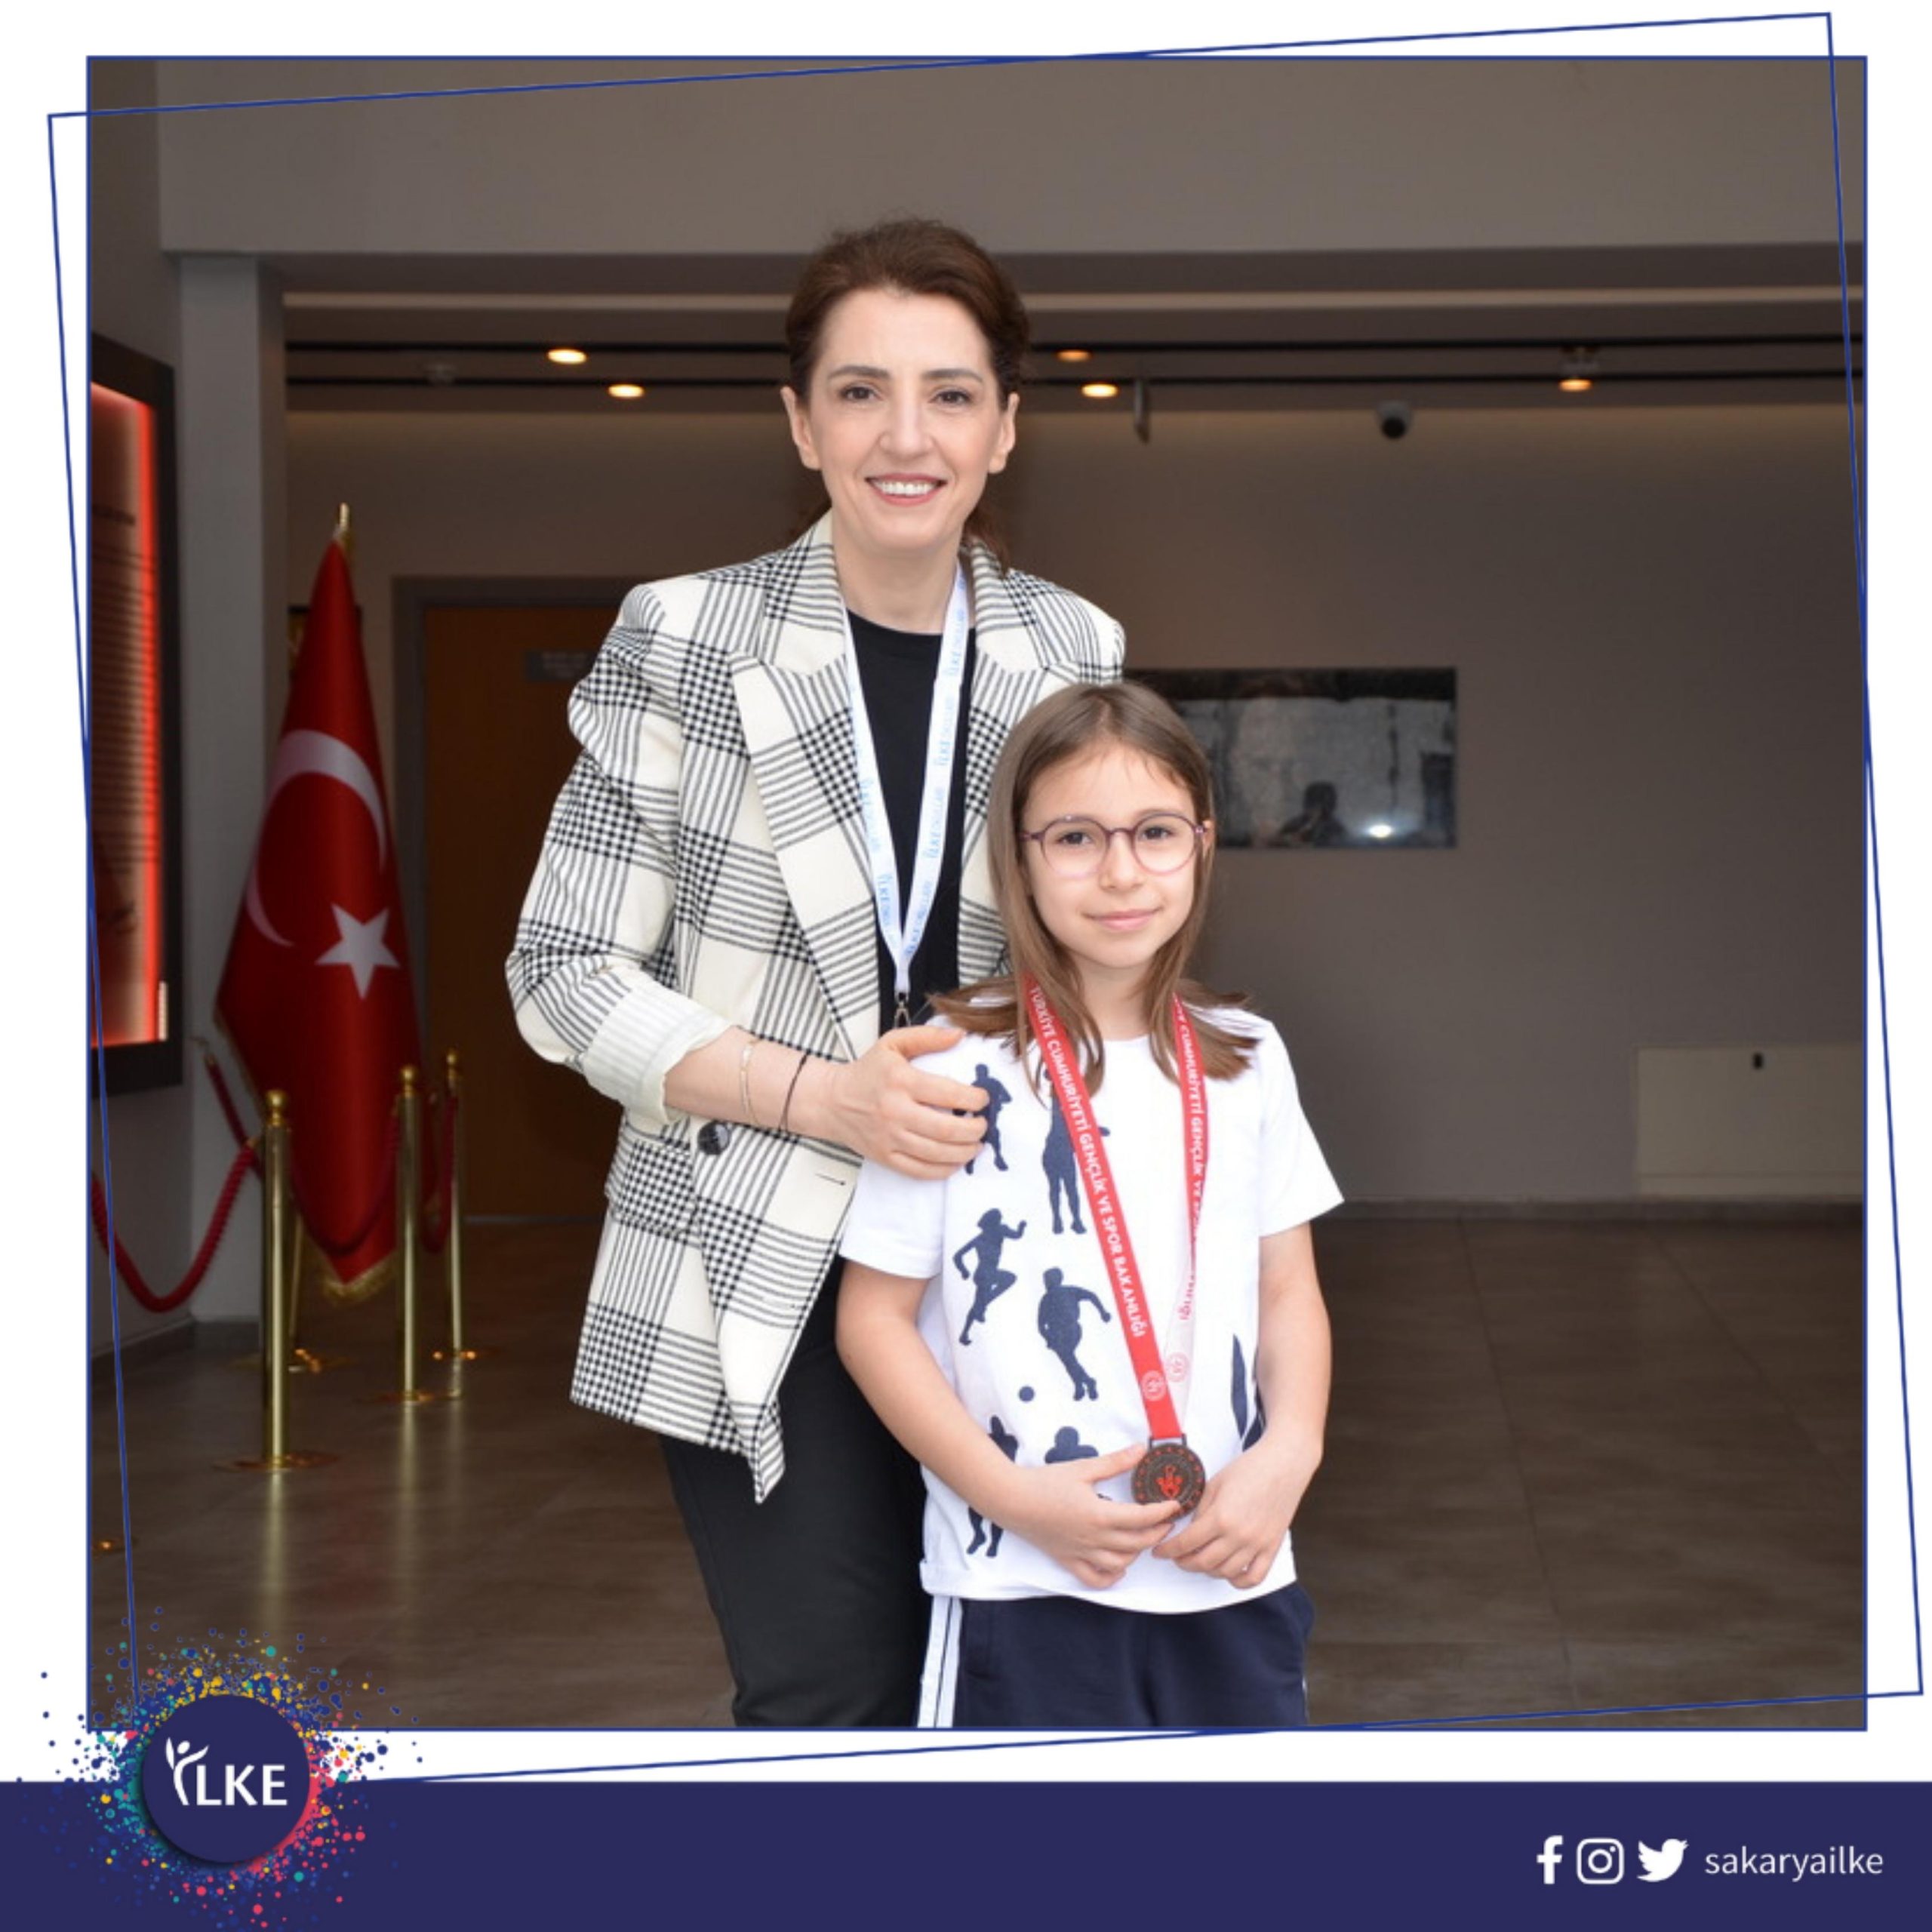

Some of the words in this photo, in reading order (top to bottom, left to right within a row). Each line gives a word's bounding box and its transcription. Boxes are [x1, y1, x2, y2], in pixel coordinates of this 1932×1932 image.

[1047, 1039, 1091, 1131] CUMHURİYETİ
[1079, 1132, 1108, 1195] GENÇLİK
[1097, 1195, 1113, 1216] VE
[1102, 1216, 1123, 1255] SPOR
[1112, 1256, 1147, 1337] BAKANLIĞI
